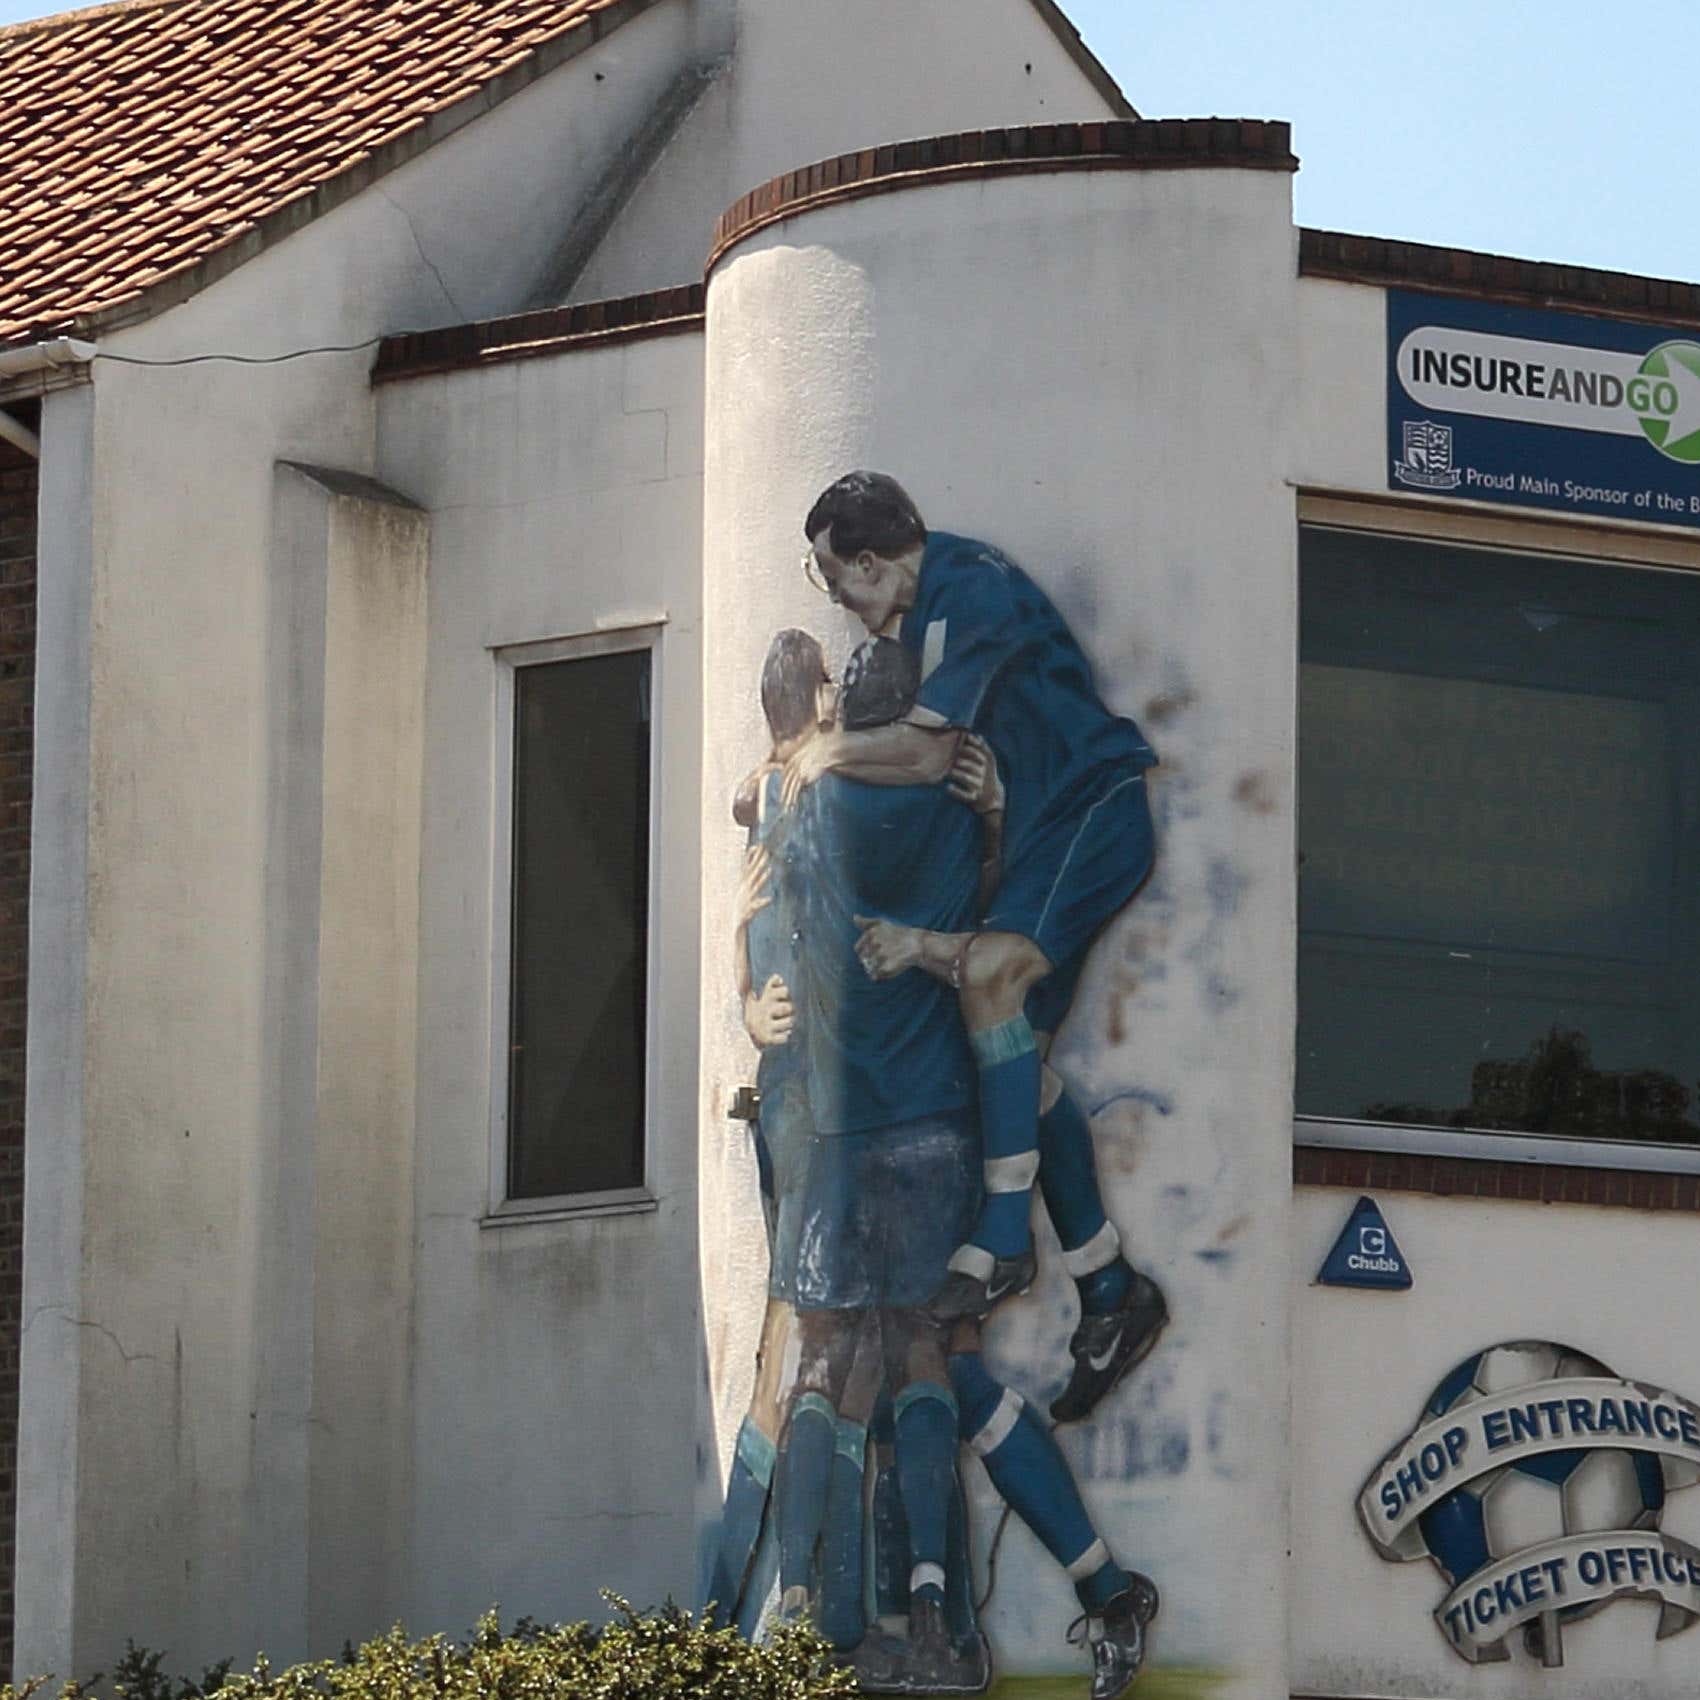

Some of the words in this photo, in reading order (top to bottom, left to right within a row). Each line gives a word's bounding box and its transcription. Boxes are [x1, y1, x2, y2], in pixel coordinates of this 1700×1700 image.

[1466, 468, 1514, 490] Proud
[1519, 475, 1560, 496] Main
[1564, 480, 1630, 504] Sponsor
[1634, 490, 1653, 507] of
[1657, 492, 1685, 512] the
[1348, 1254, 1399, 1273] Chubb
[1380, 1426, 1467, 1520] SHOP
[1445, 1558, 1567, 1642] TICKET
